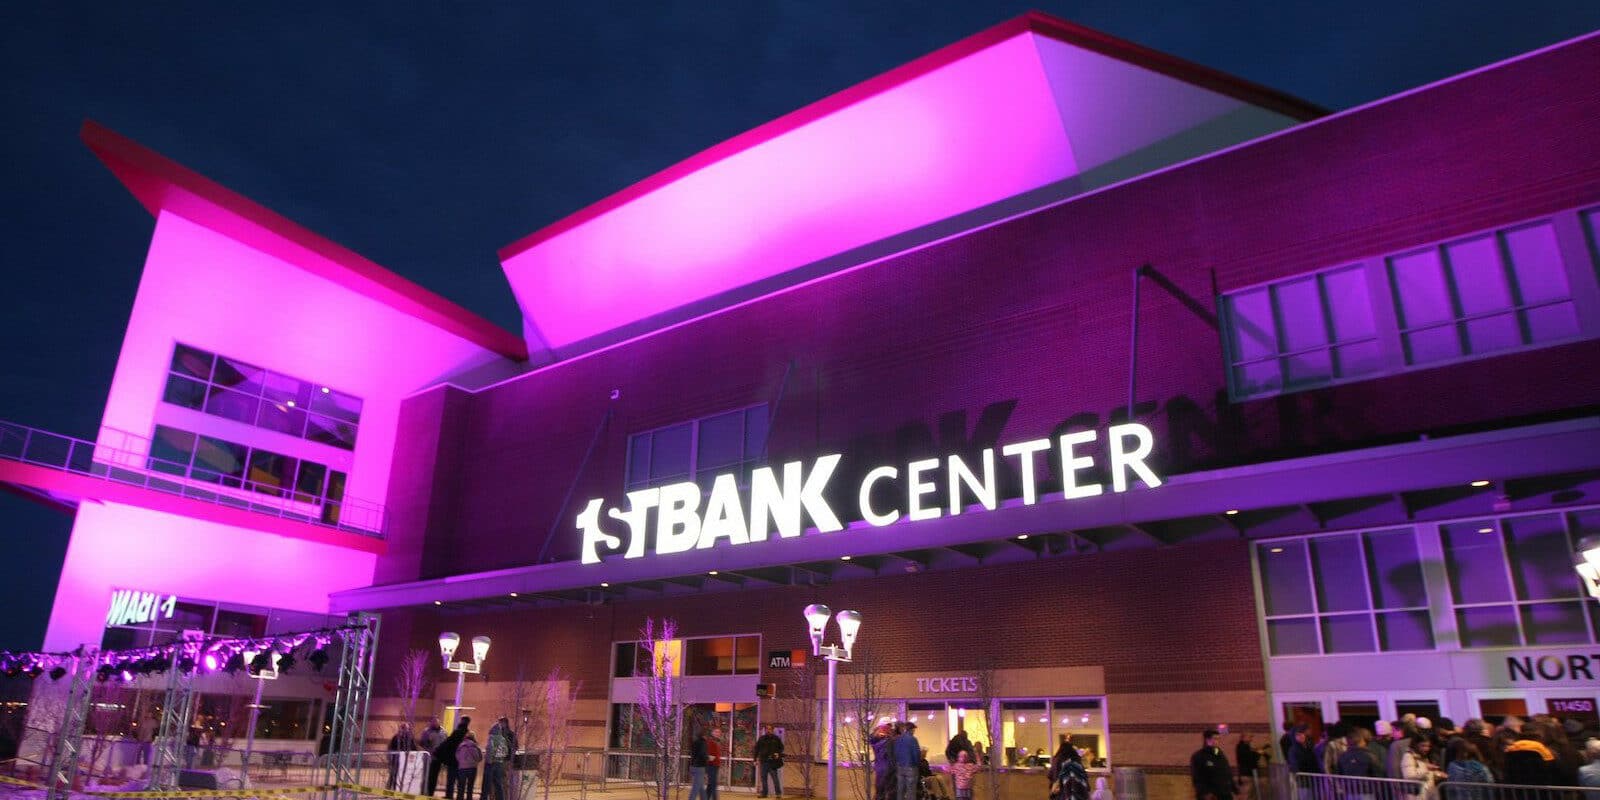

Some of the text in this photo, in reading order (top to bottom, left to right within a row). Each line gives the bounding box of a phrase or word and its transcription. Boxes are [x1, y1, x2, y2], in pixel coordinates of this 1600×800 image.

[859, 423, 1162, 528] CENTER
[769, 657, 790, 668] ATM
[916, 676, 978, 692] TICKETS
